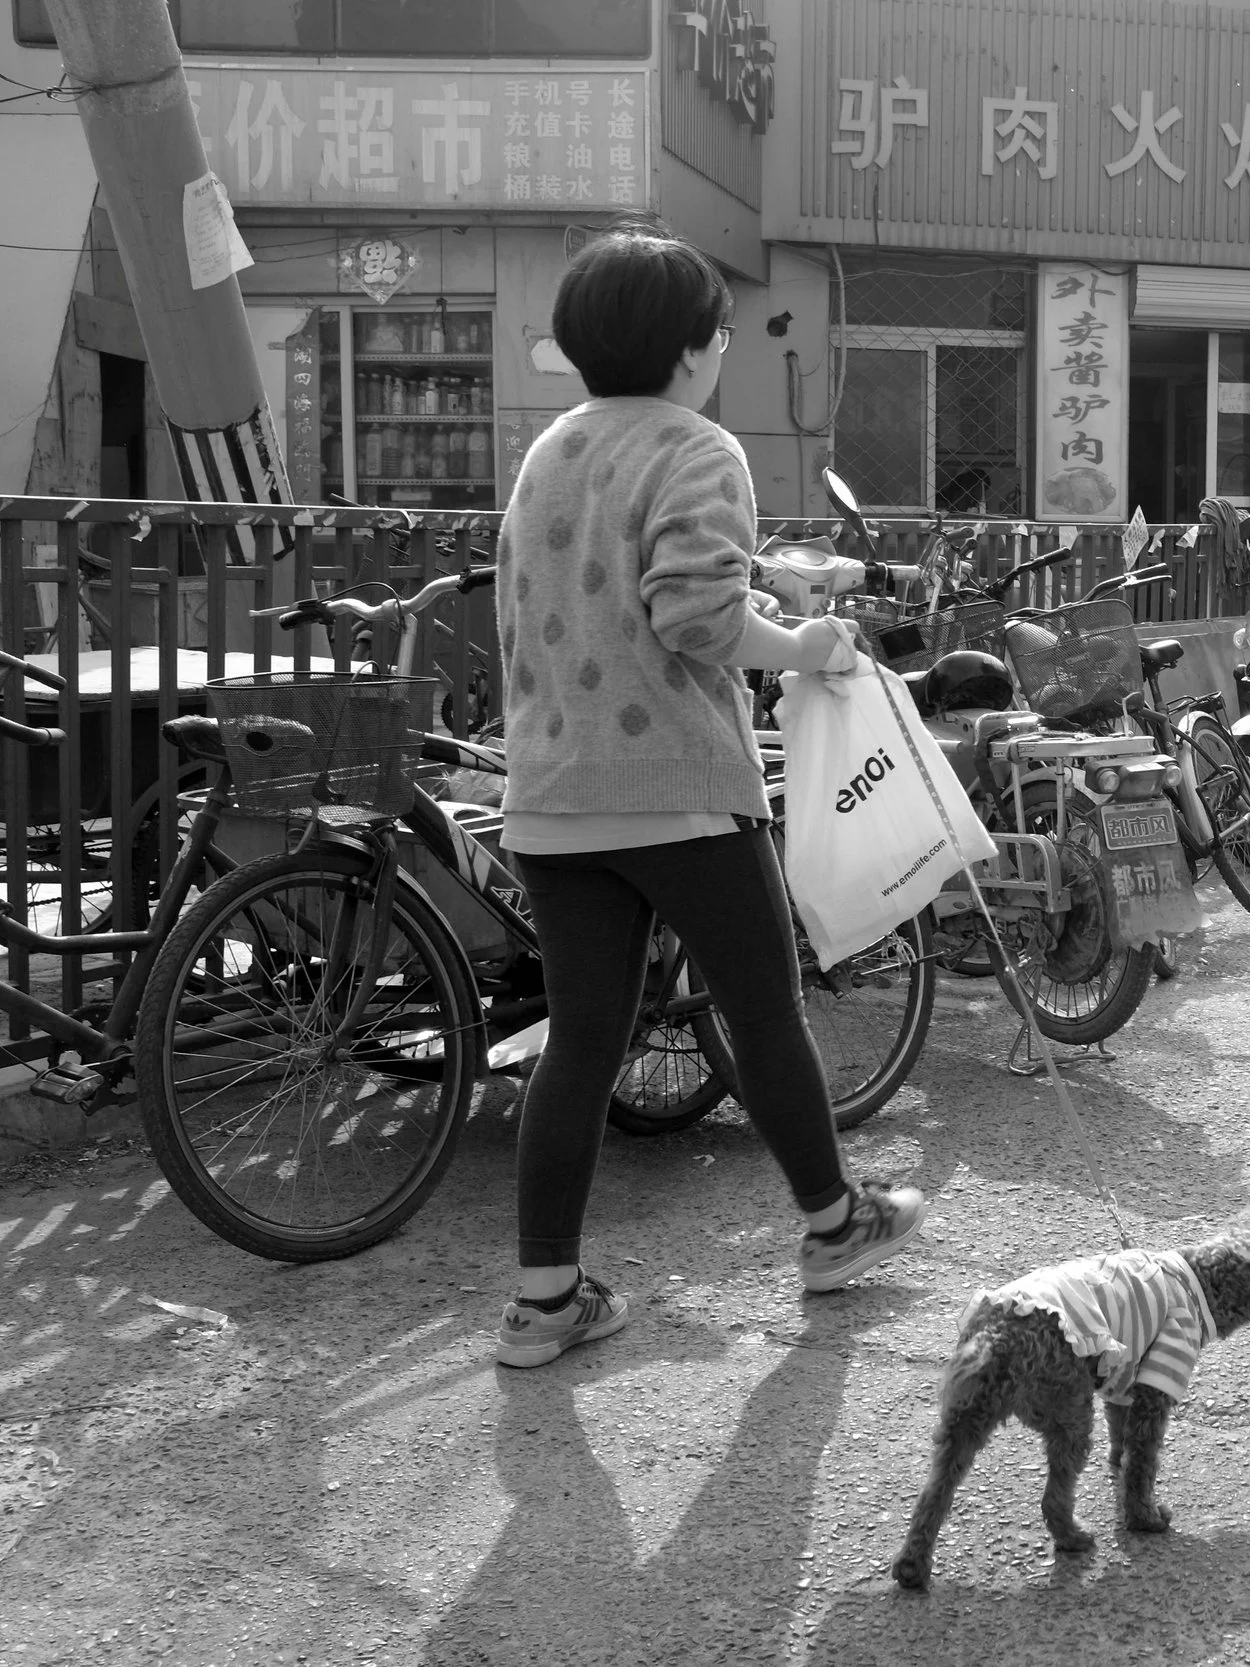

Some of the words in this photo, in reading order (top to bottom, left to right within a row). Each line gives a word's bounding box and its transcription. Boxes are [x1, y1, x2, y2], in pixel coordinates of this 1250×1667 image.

[504, 80, 592, 105] 手机号
[187, 80, 490, 194] 价超市
[504, 111, 592, 138] 充值卡
[607, 78, 636, 203] 长途电话
[503, 174, 593, 200] 桶装水
[1050, 273, 1116, 465] 外卖酱驴肉
[1108, 814, 1170, 839] 都市风
